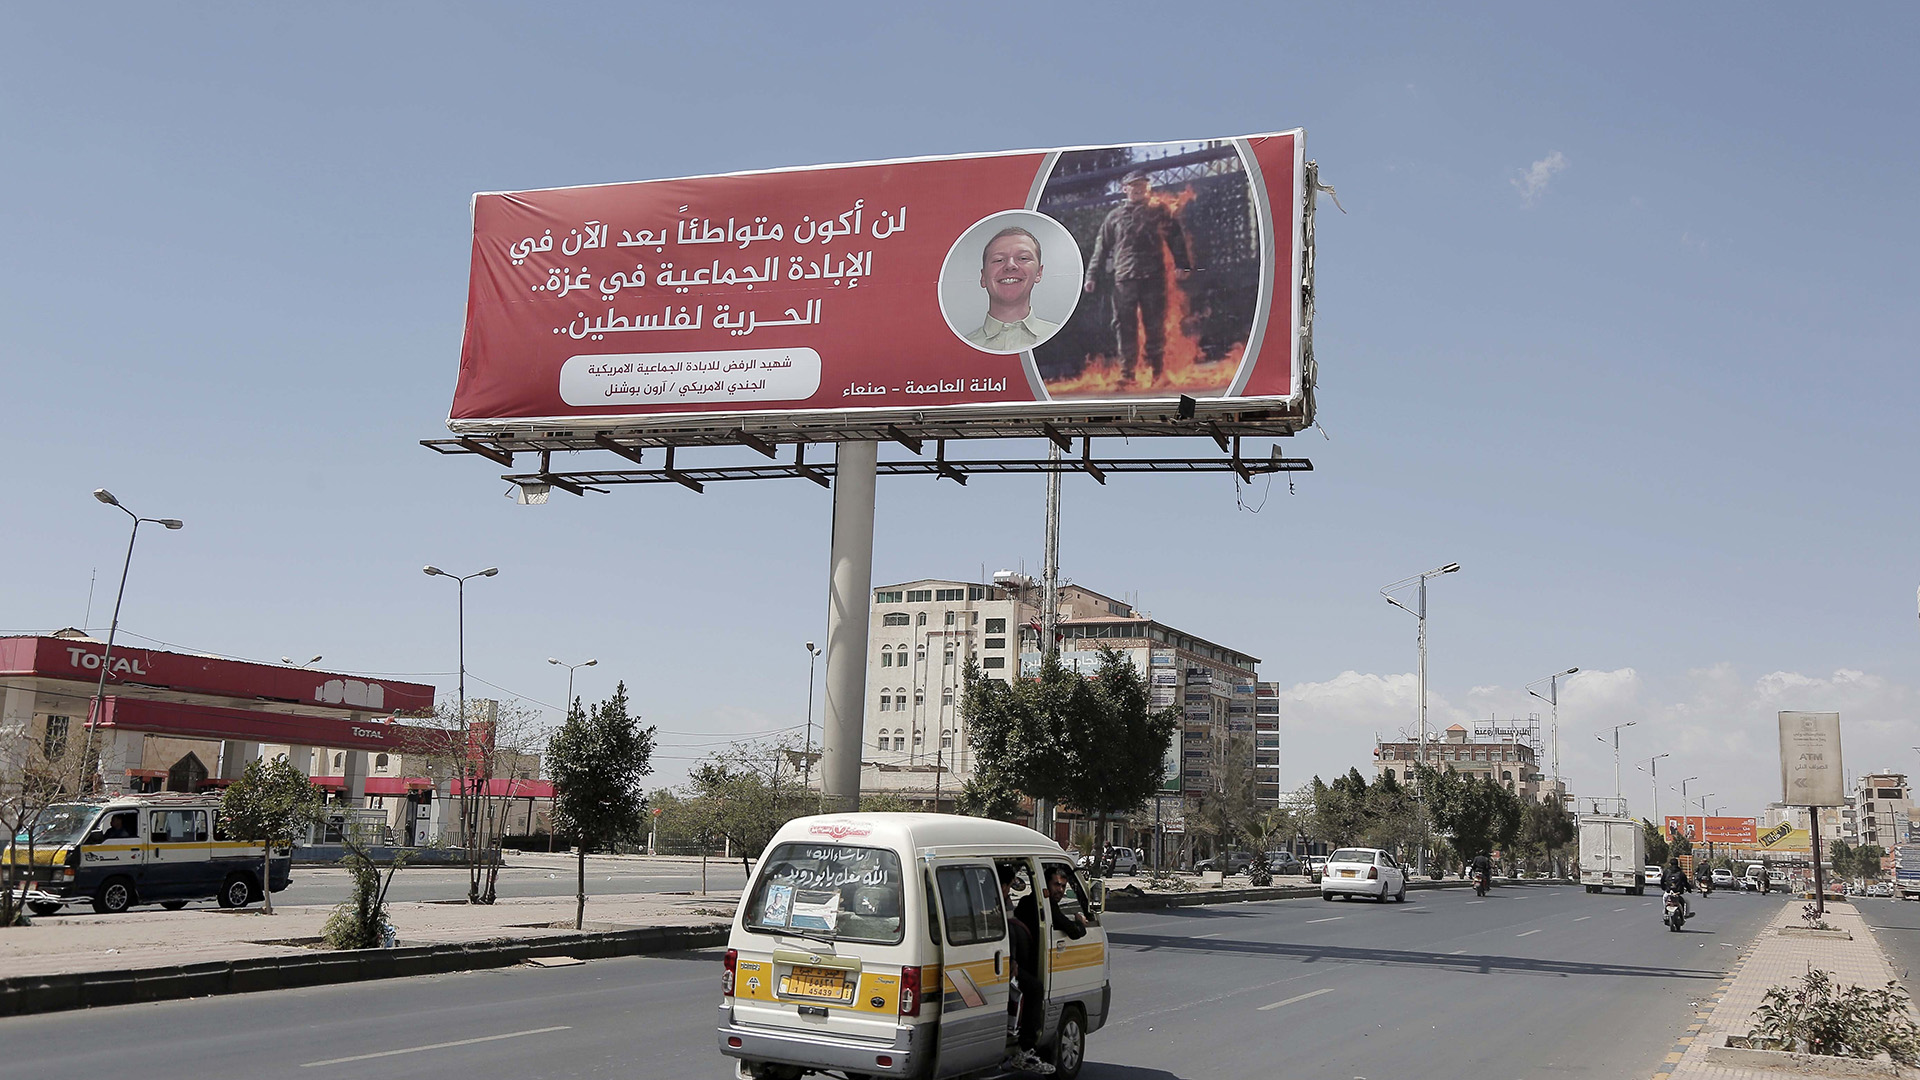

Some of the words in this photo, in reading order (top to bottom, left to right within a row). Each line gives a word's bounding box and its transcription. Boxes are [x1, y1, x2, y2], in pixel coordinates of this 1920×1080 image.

[794, 198, 864, 244] أكون
[871, 206, 907, 239] لن
[561, 220, 609, 256] الآن
[617, 229, 667, 253] بعد
[509, 229, 554, 266] في
[656, 256, 780, 294] الجماعية
[788, 251, 872, 289] الإبادة
[599, 263, 646, 301] في
[588, 363, 633, 376] الامريكية
[636, 361, 683, 375] الجماعية
[685, 360, 720, 372] للابادة
[722, 359, 757, 373] الرفض
[760, 355, 792, 370] شهيد
[604, 383, 640, 397] بوشنل
[643, 380, 667, 395] آرون
[678, 381, 724, 396] الامريكي
[728, 379, 766, 394] الجندي
[842, 382, 887, 398] صنعاء
[905, 378, 965, 395] العاصمة
[969, 377, 1007, 392] امانة
[66, 647, 146, 676] TOTAL
[351, 726, 384, 739] TOTAL
[1799, 753, 1823, 761] ATM
[808, 987, 833, 997] 45439
